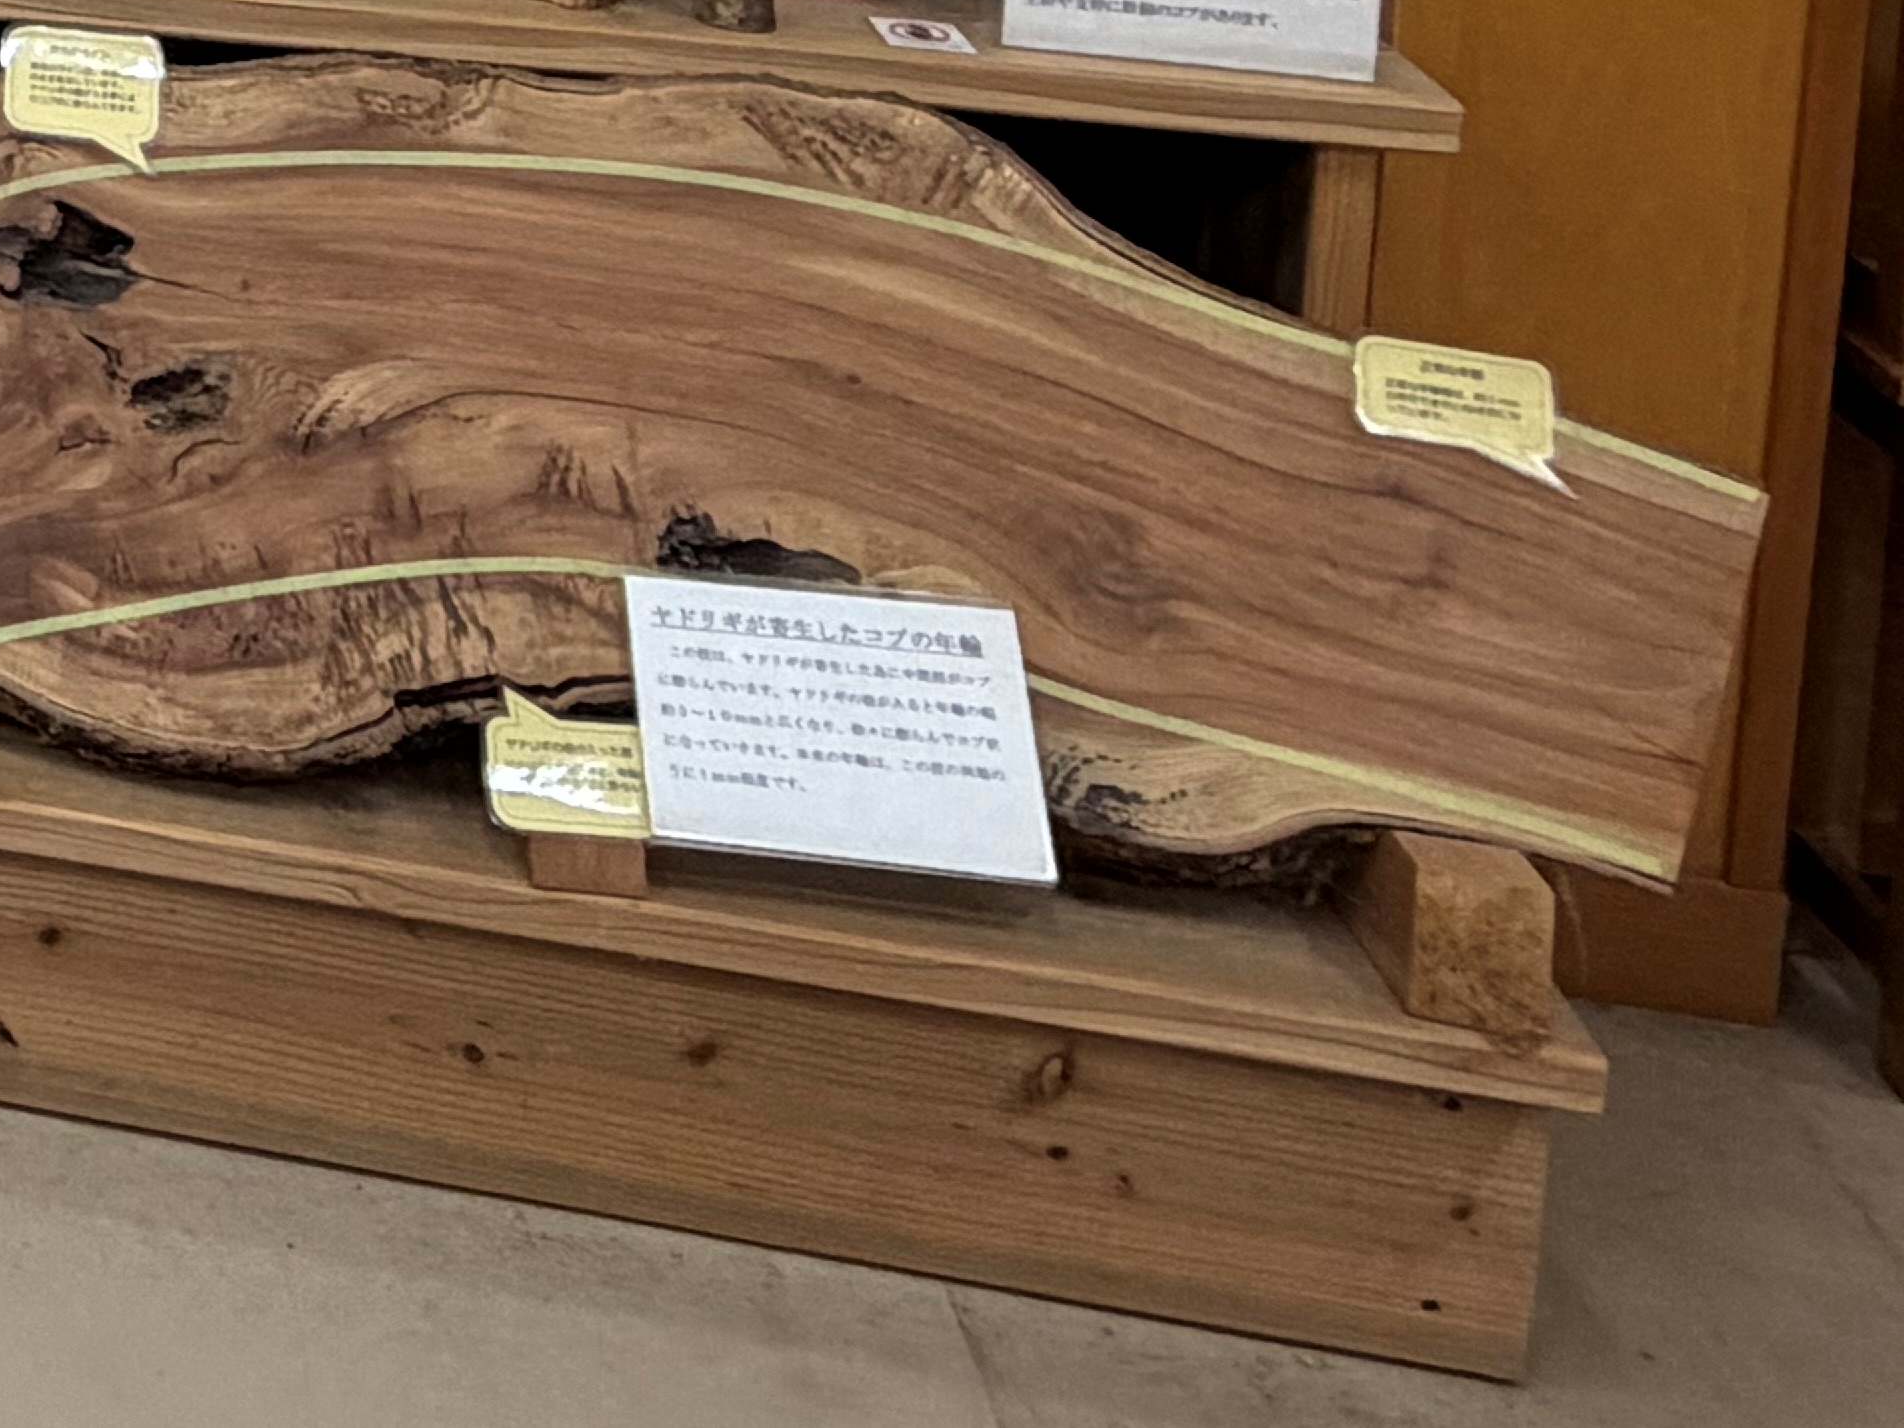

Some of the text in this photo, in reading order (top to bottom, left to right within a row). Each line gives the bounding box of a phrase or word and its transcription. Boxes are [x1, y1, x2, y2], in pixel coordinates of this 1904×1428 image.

[650, 604, 983, 657] ヤドリギが寄生したコブの年輪
